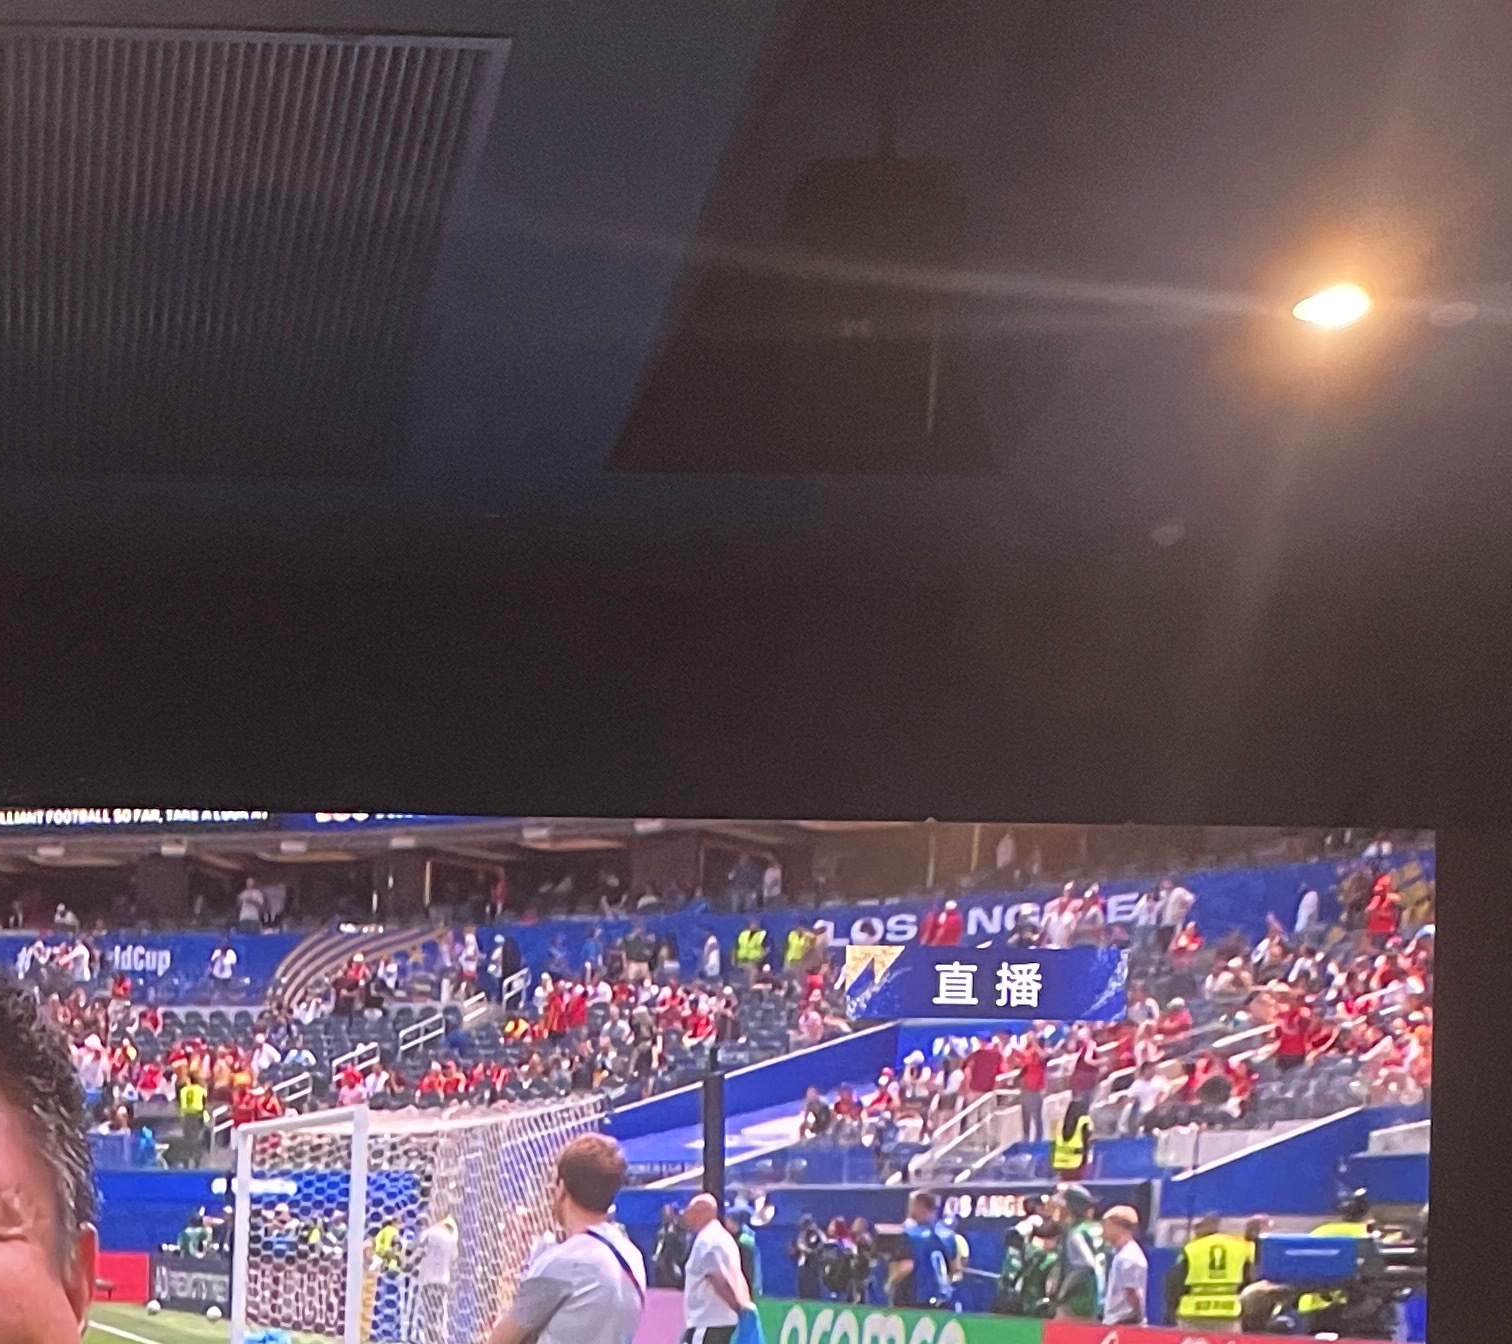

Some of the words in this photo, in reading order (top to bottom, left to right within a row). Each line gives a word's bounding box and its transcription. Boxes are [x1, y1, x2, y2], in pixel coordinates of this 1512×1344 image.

[45, 808, 112, 825] FOOTBALL
[113, 808, 132, 824] SO
[813, 913, 918, 947] LOS
[932, 961, 1042, 1008] 直播
